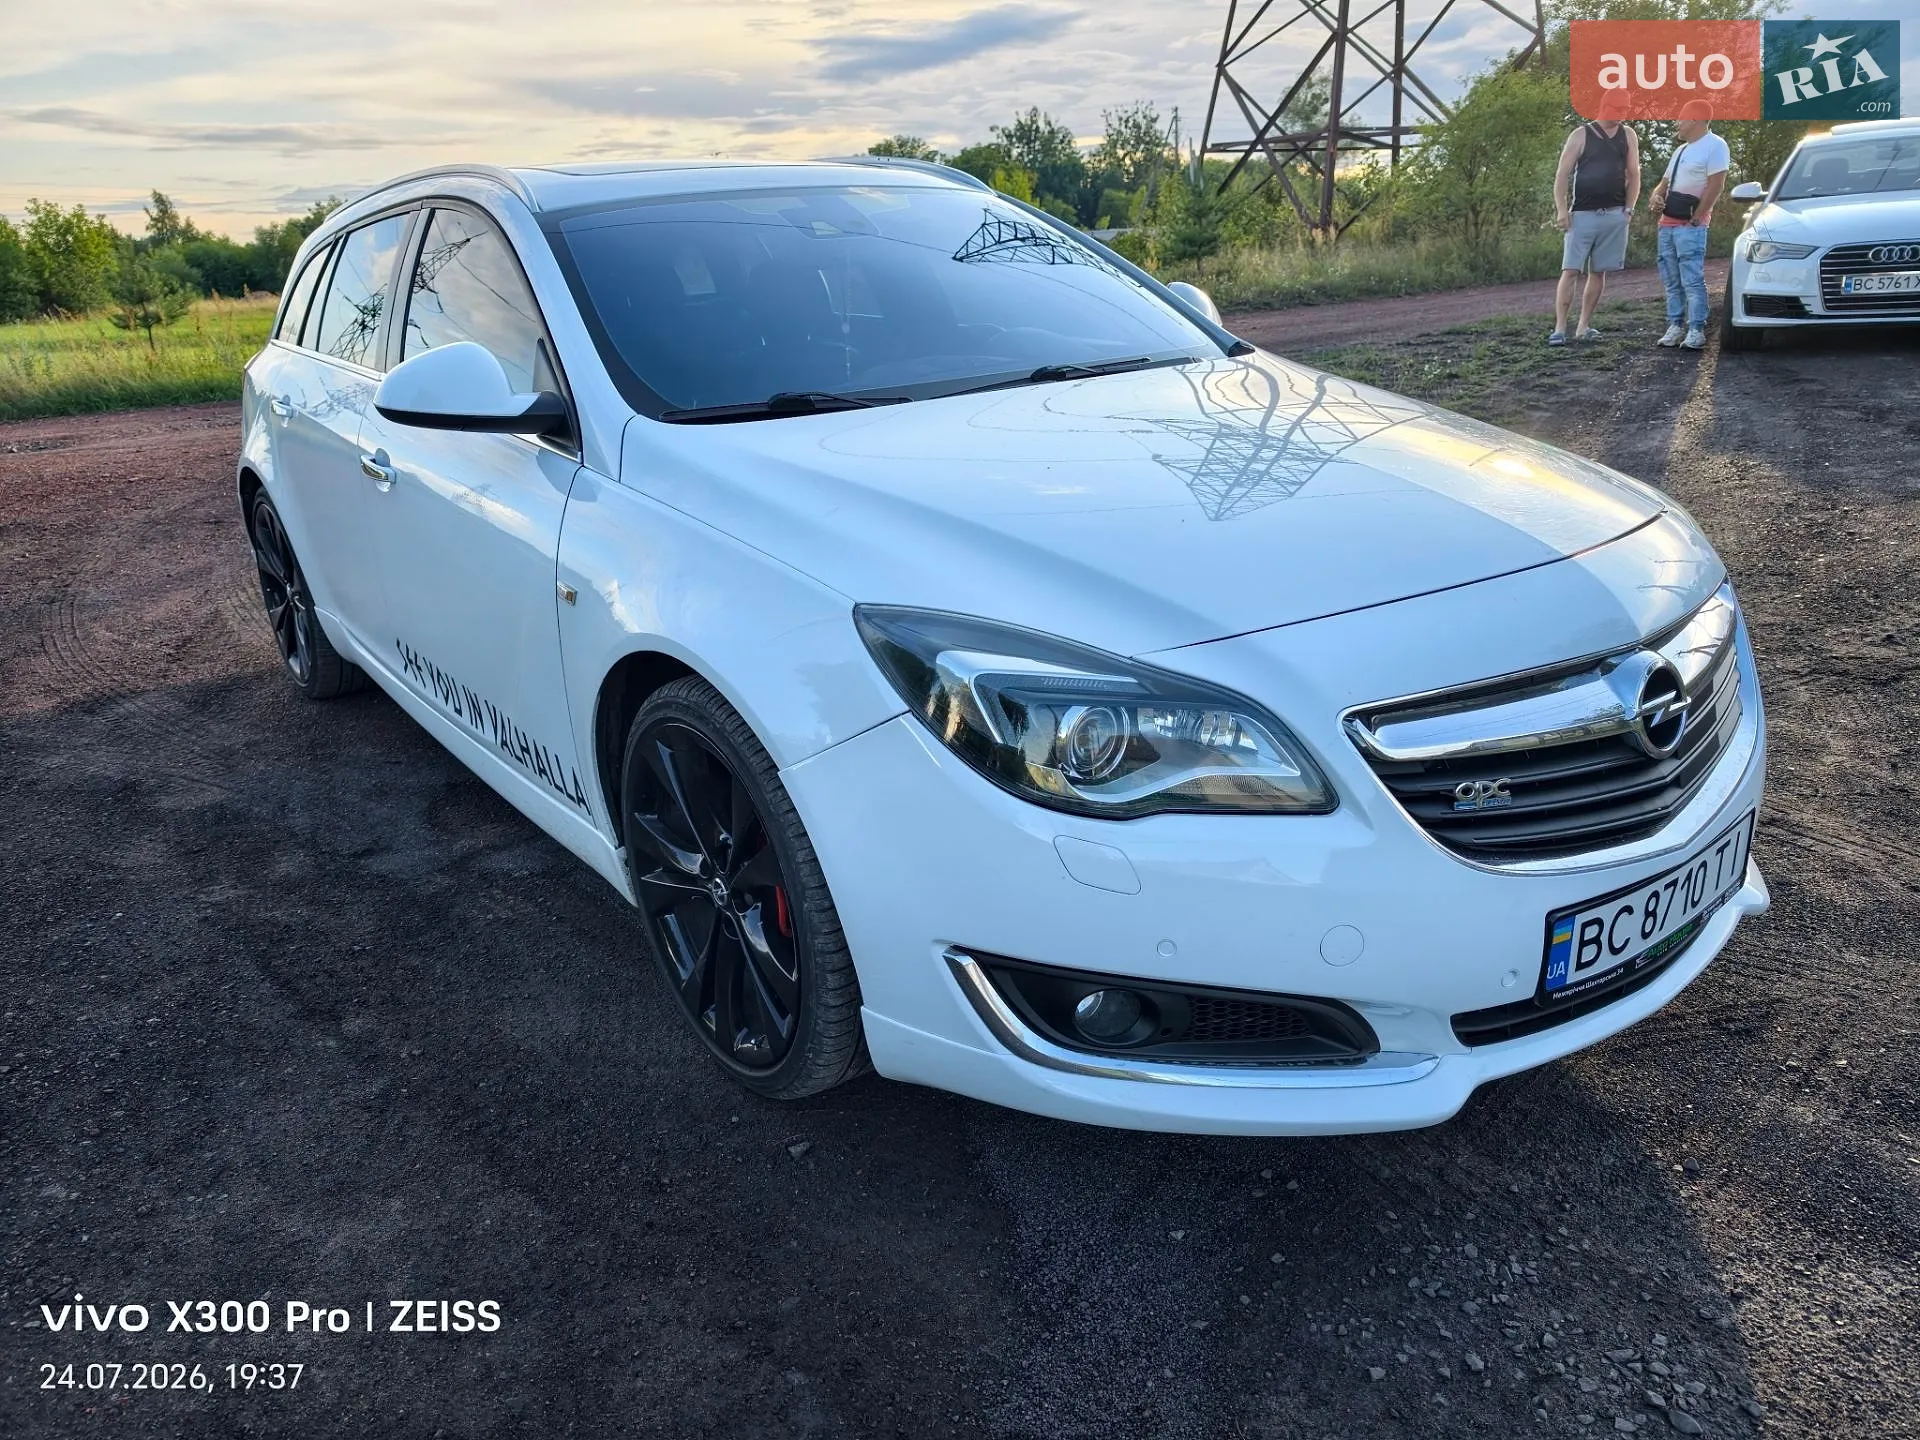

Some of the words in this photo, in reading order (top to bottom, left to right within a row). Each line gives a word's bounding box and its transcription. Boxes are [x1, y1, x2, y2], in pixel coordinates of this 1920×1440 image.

[1853, 278, 1874, 291] BC
[1878, 276, 1911, 290] 5761
[423, 656, 463, 718] YOU
[462, 685, 485, 734] IN
[484, 699, 592, 816] VALHALLA
[1574, 904, 1635, 973] BC
[1641, 860, 1708, 941] 8710
[1715, 831, 1741, 890] TI
[1546, 961, 1566, 979] UA
